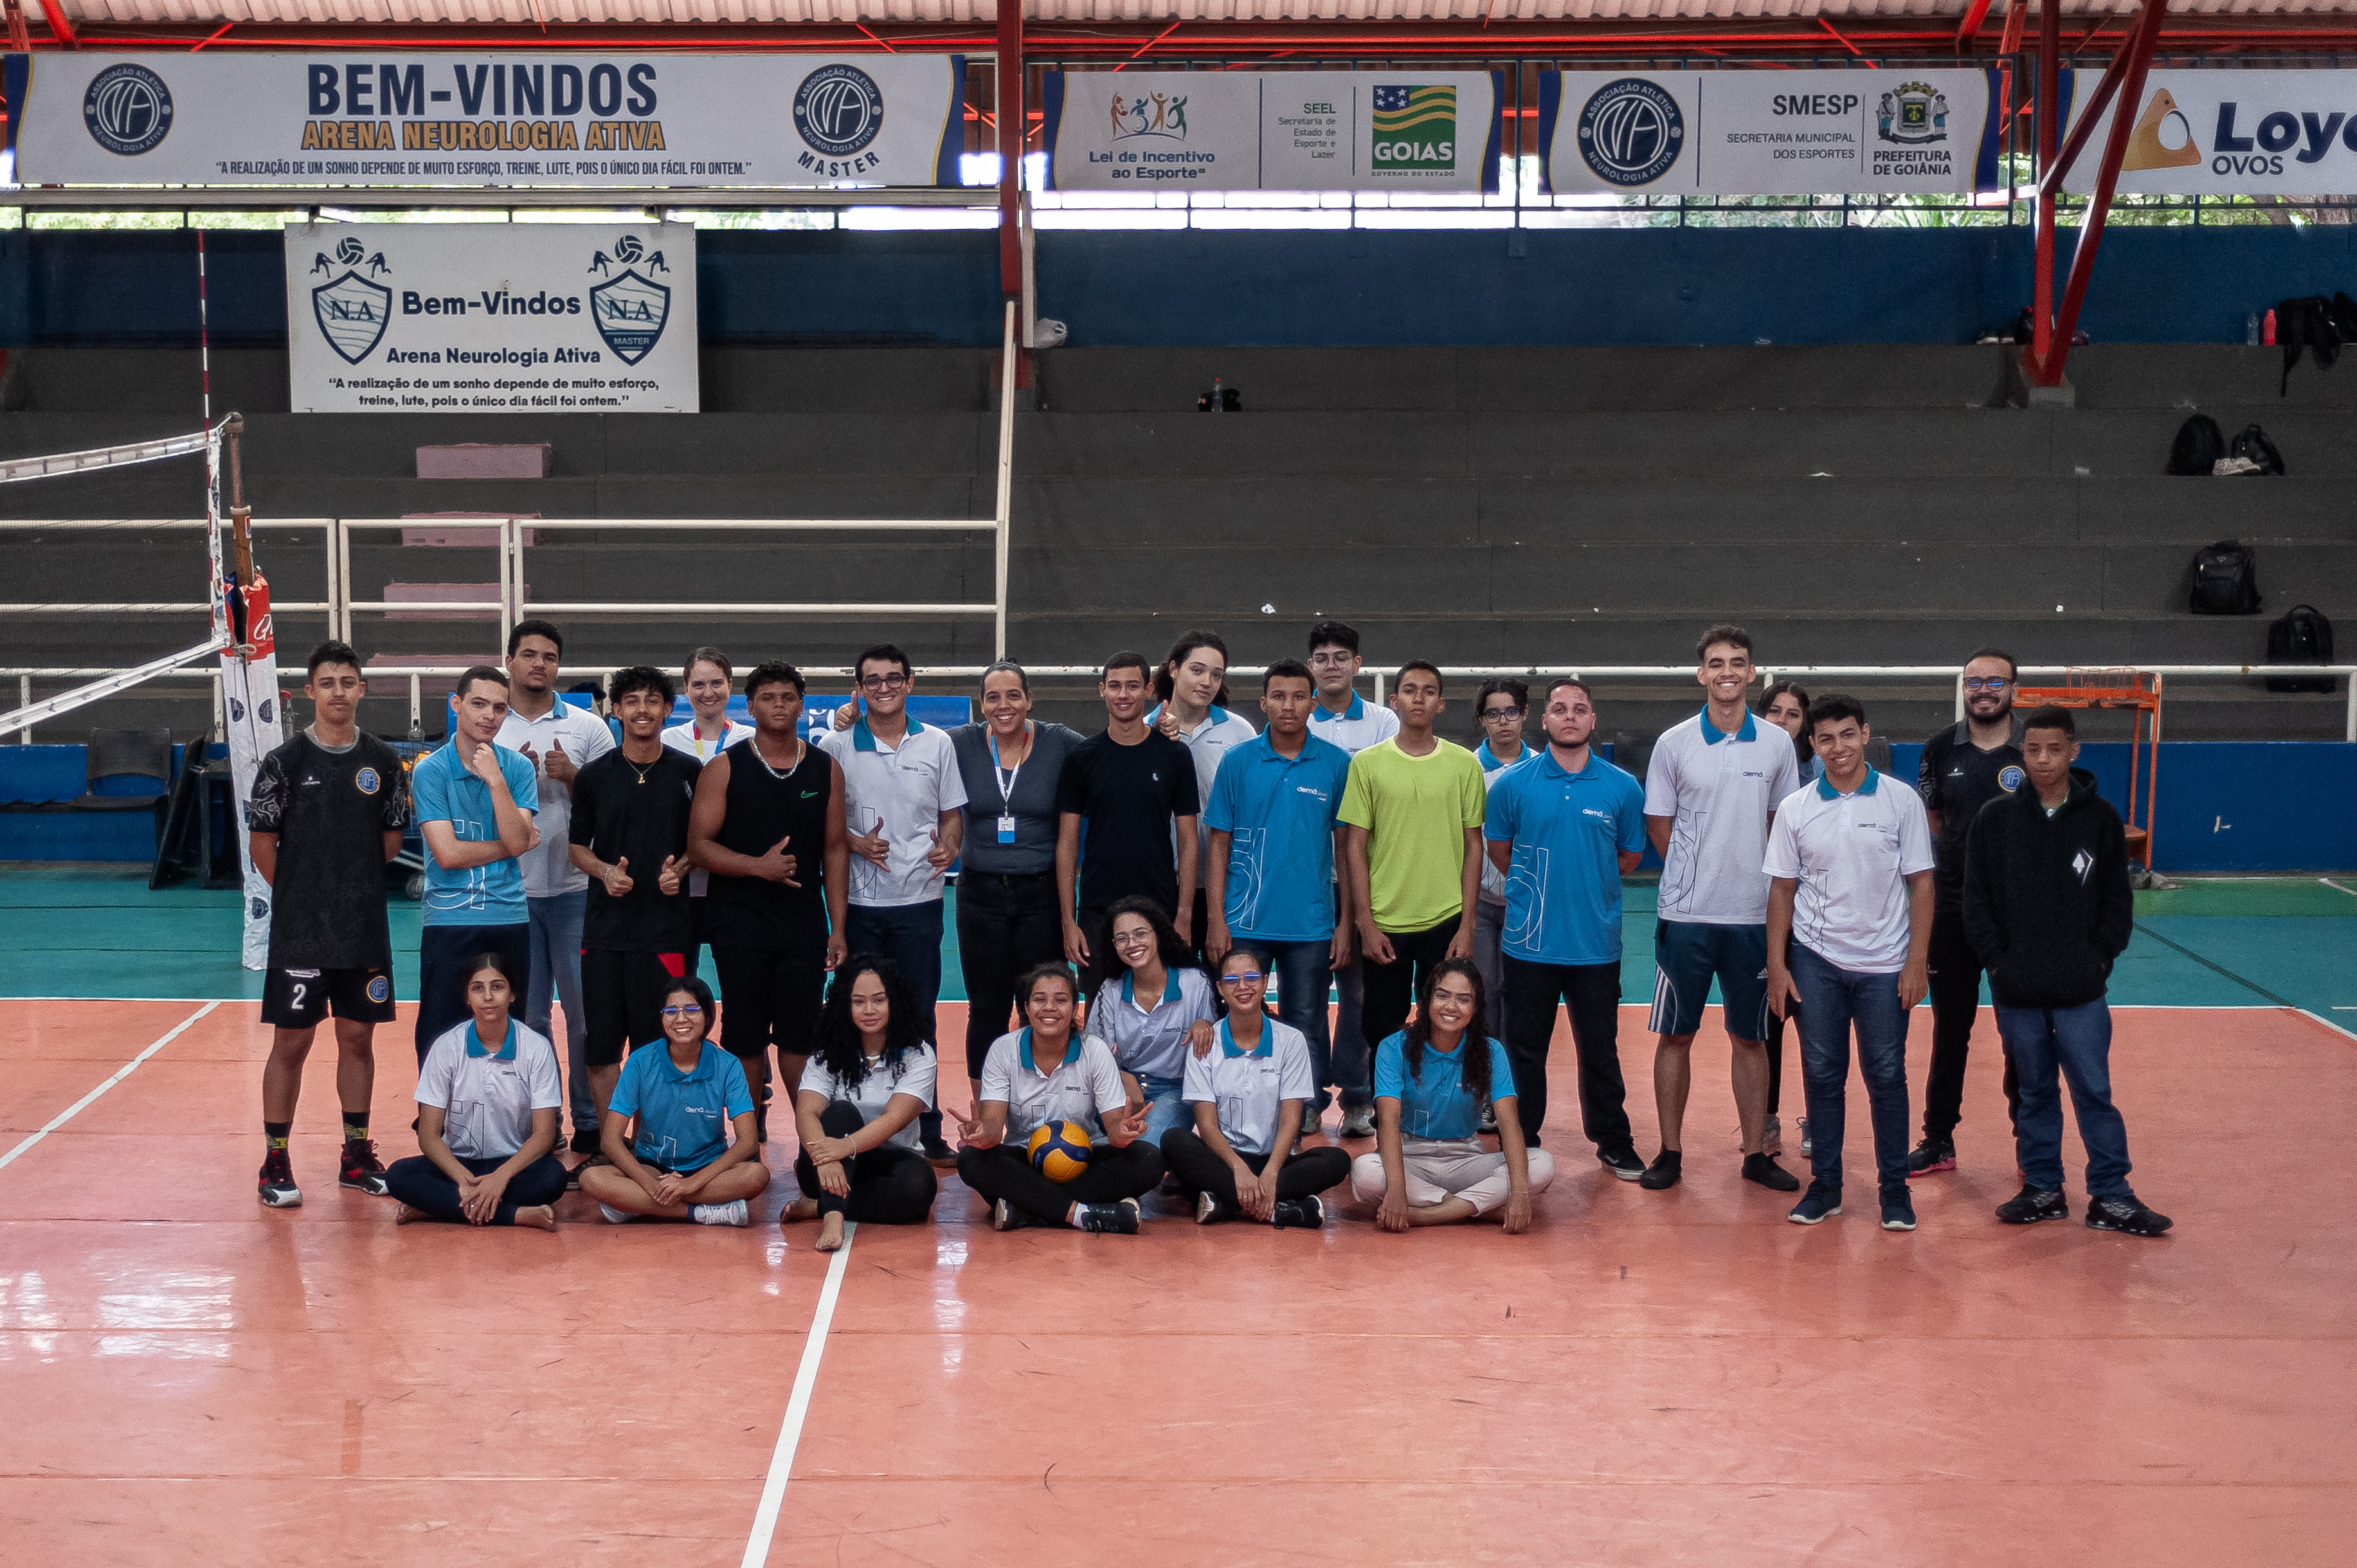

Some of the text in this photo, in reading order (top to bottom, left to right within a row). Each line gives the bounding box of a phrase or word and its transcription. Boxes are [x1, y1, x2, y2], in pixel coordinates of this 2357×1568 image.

[91, 68, 165, 98] ASSOCIAÇÃO ATLÉTICA
[308, 64, 658, 118] BEM-VINDOS
[800, 68, 876, 100] ASSOCIAÇÃO ATLÉTICA
[1303, 103, 1337, 114] SEEL
[1587, 82, 1675, 120] ASSOCIAÇÃO ATLÉTICA
[1773, 95, 1859, 116] SMESP
[1278, 117, 1323, 126] Secretaria
[93, 125, 165, 151] NEUROLOGIA ATIVA
[301, 120, 667, 152] ARENA NEUROLOGIA ATIVA
[802, 126, 875, 152] NEUROLOGIA ATIVA
[1294, 128, 1337, 137] Estado de
[1727, 133, 1856, 144] SECRETARIA MUNICIPAL
[1294, 140, 1328, 149] Esporte
[797, 150, 880, 177] MASTER
[1089, 151, 1216, 163] Lei de Incentivo
[1312, 151, 1336, 159] Lazer
[1774, 149, 1855, 160] DOS ESPORTES
[1874, 150, 1952, 162] PREFEITURA
[231, 159, 291, 177] REALIZAÇÃO
[293, 162, 305, 176] DE
[308, 162, 324, 176] UM
[326, 162, 359, 176] SONHO
[362, 162, 406, 176] DEPENDE
[409, 162, 422, 176] DE
[424, 162, 455, 176] MUITO
[457, 162, 504, 178] ESFORÇO,
[506, 162, 545, 177] TREINE,
[546, 162, 574, 177] LUTE,
[577, 162, 599, 176] POIS
[601, 162, 608, 176] O
[610, 160, 640, 176] ÚNICO
[643, 162, 659, 176] DIA
[662, 159, 689, 176] FÁCIL
[691, 162, 707, 176] FOI
[1112, 167, 1198, 181] ao Esporte
[1588, 151, 1673, 181] NEUROLOGIA ATIVA
[1874, 161, 1952, 176] DE GOIÂNIA
[2212, 155, 2284, 176] OVOS
[402, 290, 581, 316] Bem-Vindos
[614, 338, 650, 346] MASTER
[387, 348, 601, 368] Arena Neurologia Ativa
[348, 378, 411, 392] realização
[413, 378, 430, 390] de
[433, 381, 451, 390] um
[453, 379, 491, 390] sonho
[494, 379, 550, 392] depende
[553, 379, 570, 390] de
[572, 378, 606, 389] muito
[609, 378, 660, 392] esforço,
[359, 395, 399, 408] treine,
[402, 395, 429, 408] lute,
[432, 395, 459, 409] pois
[462, 399, 470, 407] o
[473, 396, 507, 407] único
[509, 396, 528, 407] dia
[531, 395, 558, 407] fácil
[560, 395, 577, 406] foi
[291, 984, 307, 1010] 2
